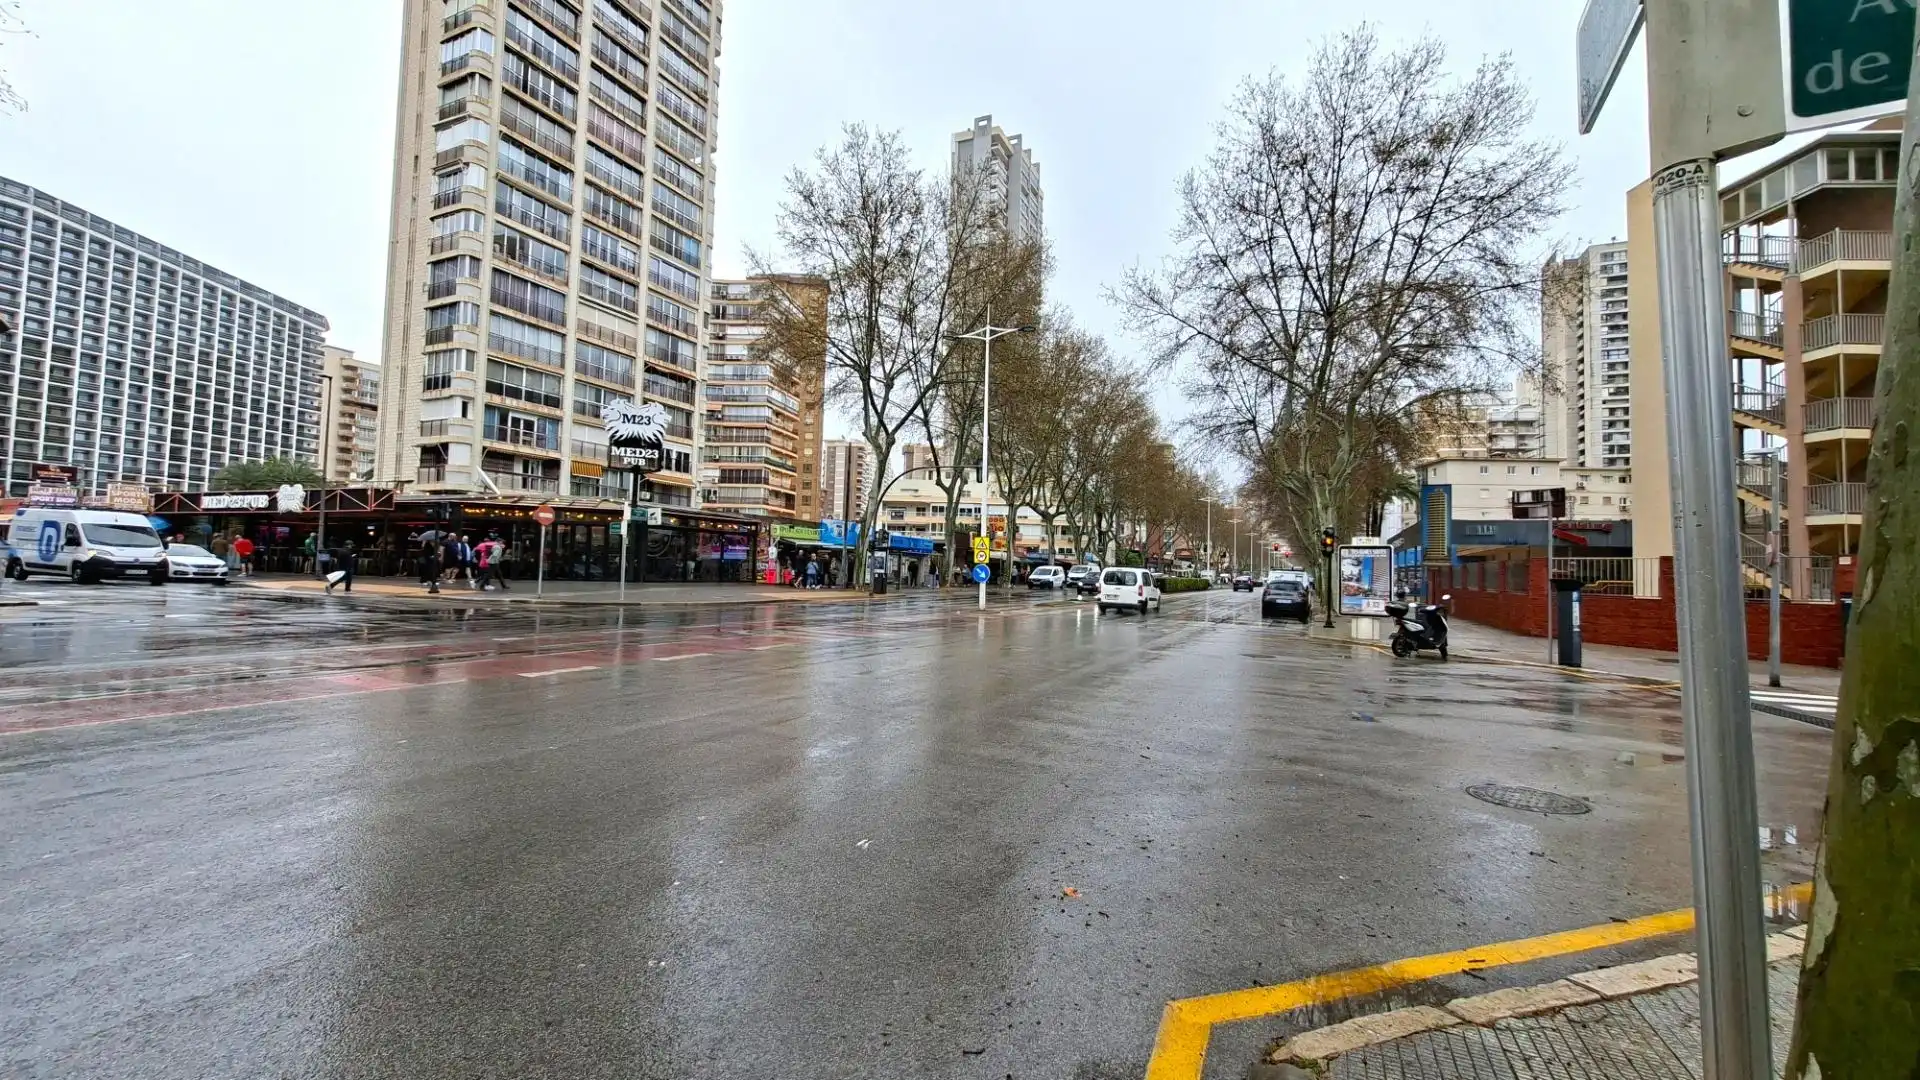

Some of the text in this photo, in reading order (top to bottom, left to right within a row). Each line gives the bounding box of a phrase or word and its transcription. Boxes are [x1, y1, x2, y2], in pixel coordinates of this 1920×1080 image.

[1804, 48, 1892, 94] de
[621, 413, 652, 425] M23
[610, 446, 659, 459] MED23
[623, 457, 646, 466] PUB
